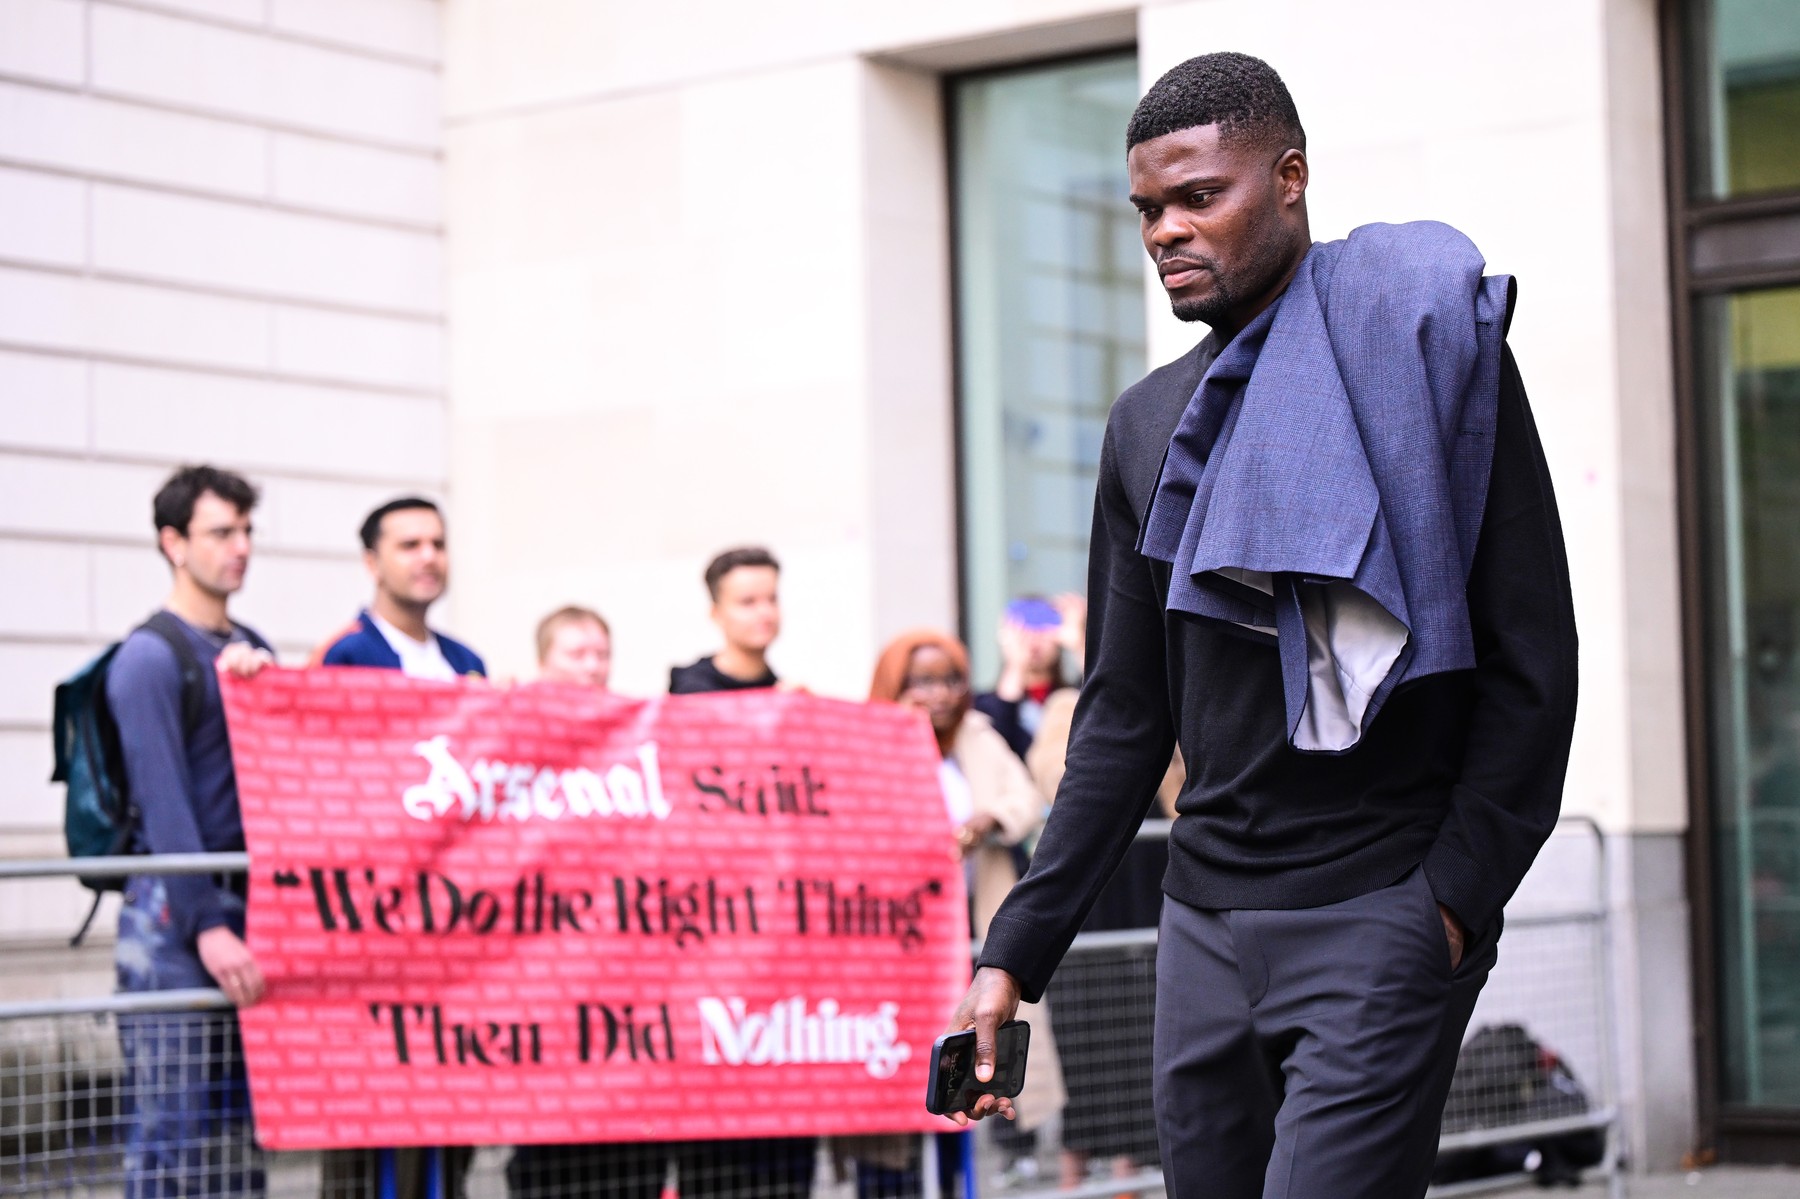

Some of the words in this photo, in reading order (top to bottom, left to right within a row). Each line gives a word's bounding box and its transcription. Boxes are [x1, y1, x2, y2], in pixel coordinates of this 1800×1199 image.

[402, 734, 672, 822] Arsenal
[415, 868, 500, 935] Do
[511, 870, 594, 934] the
[614, 876, 759, 949] Right
[369, 1002, 543, 1066] Then
[576, 1002, 677, 1064] Did
[700, 995, 912, 1079] Nothing.
